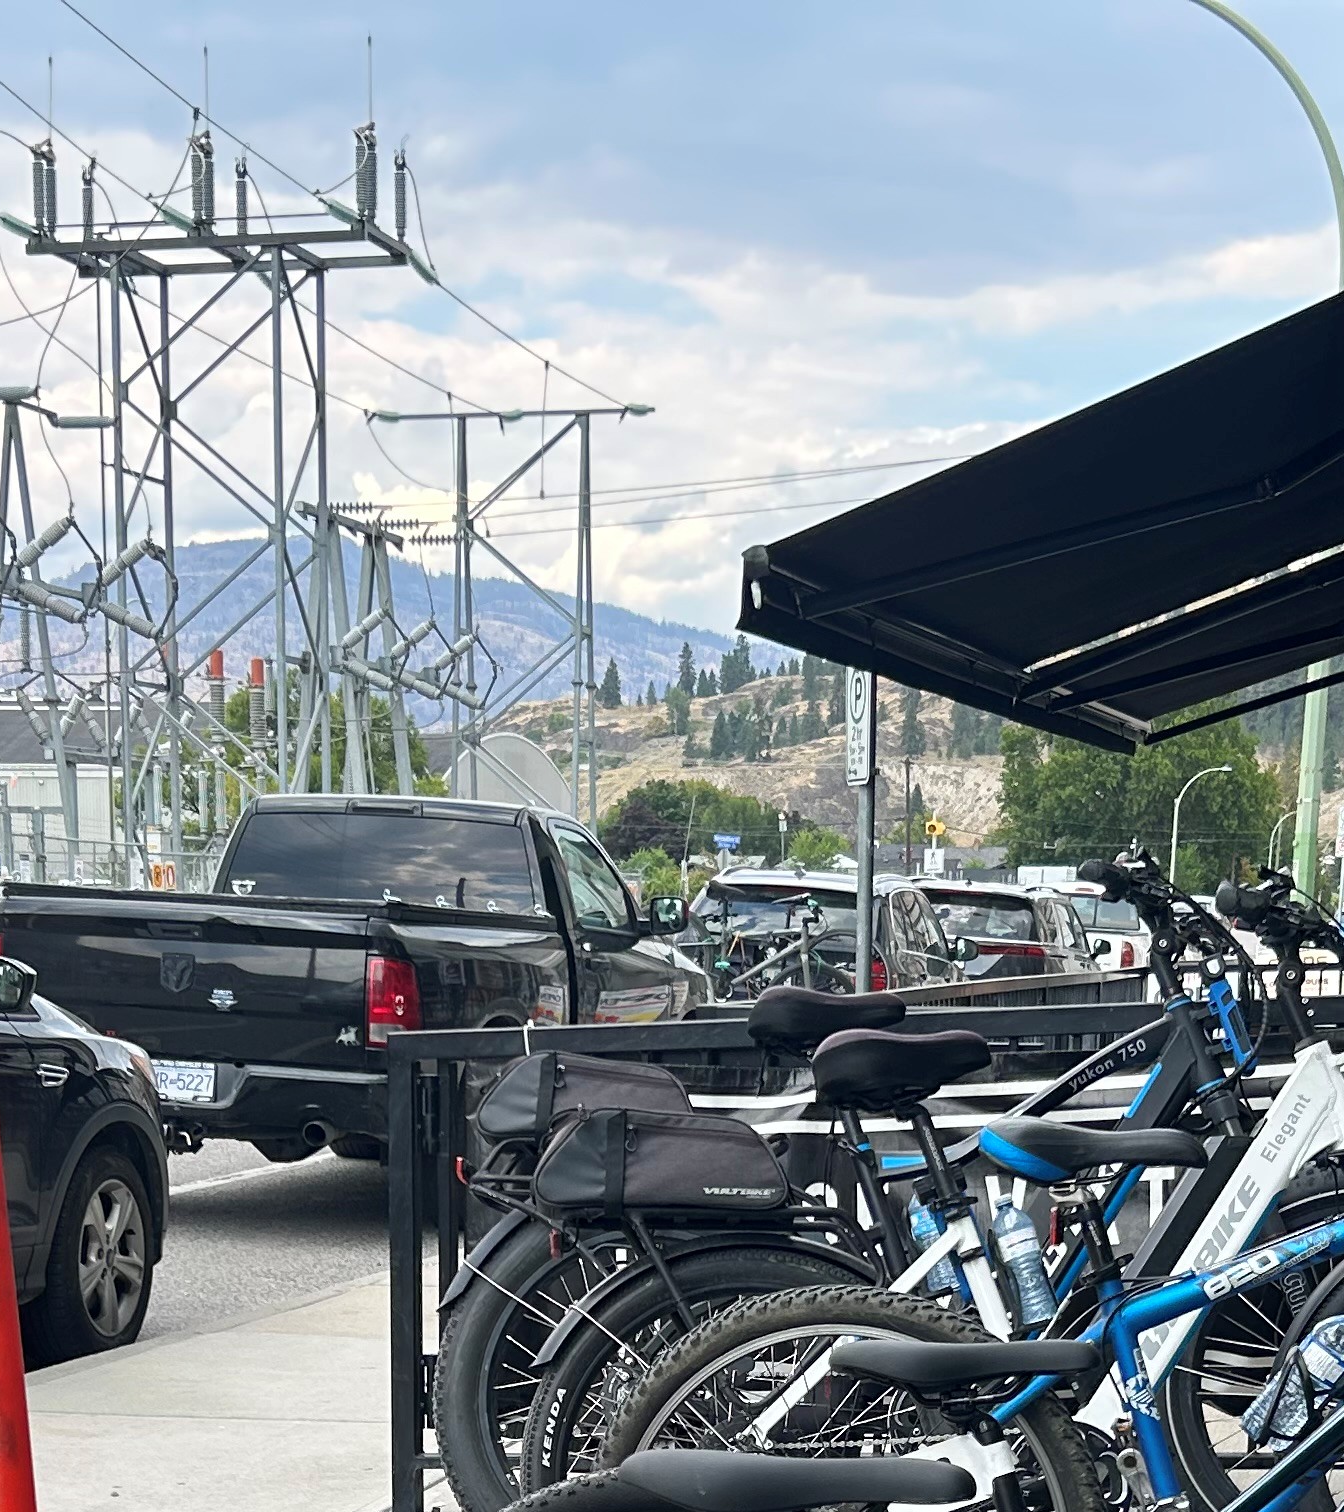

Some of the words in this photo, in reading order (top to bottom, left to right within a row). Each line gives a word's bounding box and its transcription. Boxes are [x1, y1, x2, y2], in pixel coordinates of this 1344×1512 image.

[176, 1072, 213, 1093] 5227
[1068, 1058, 1115, 1093] yukon
[1117, 1038, 1147, 1062] 750
[1260, 1093, 1311, 1164] Elegant
[1203, 1249, 1281, 1300] 820
[541, 1387, 567, 1468] KENDA
